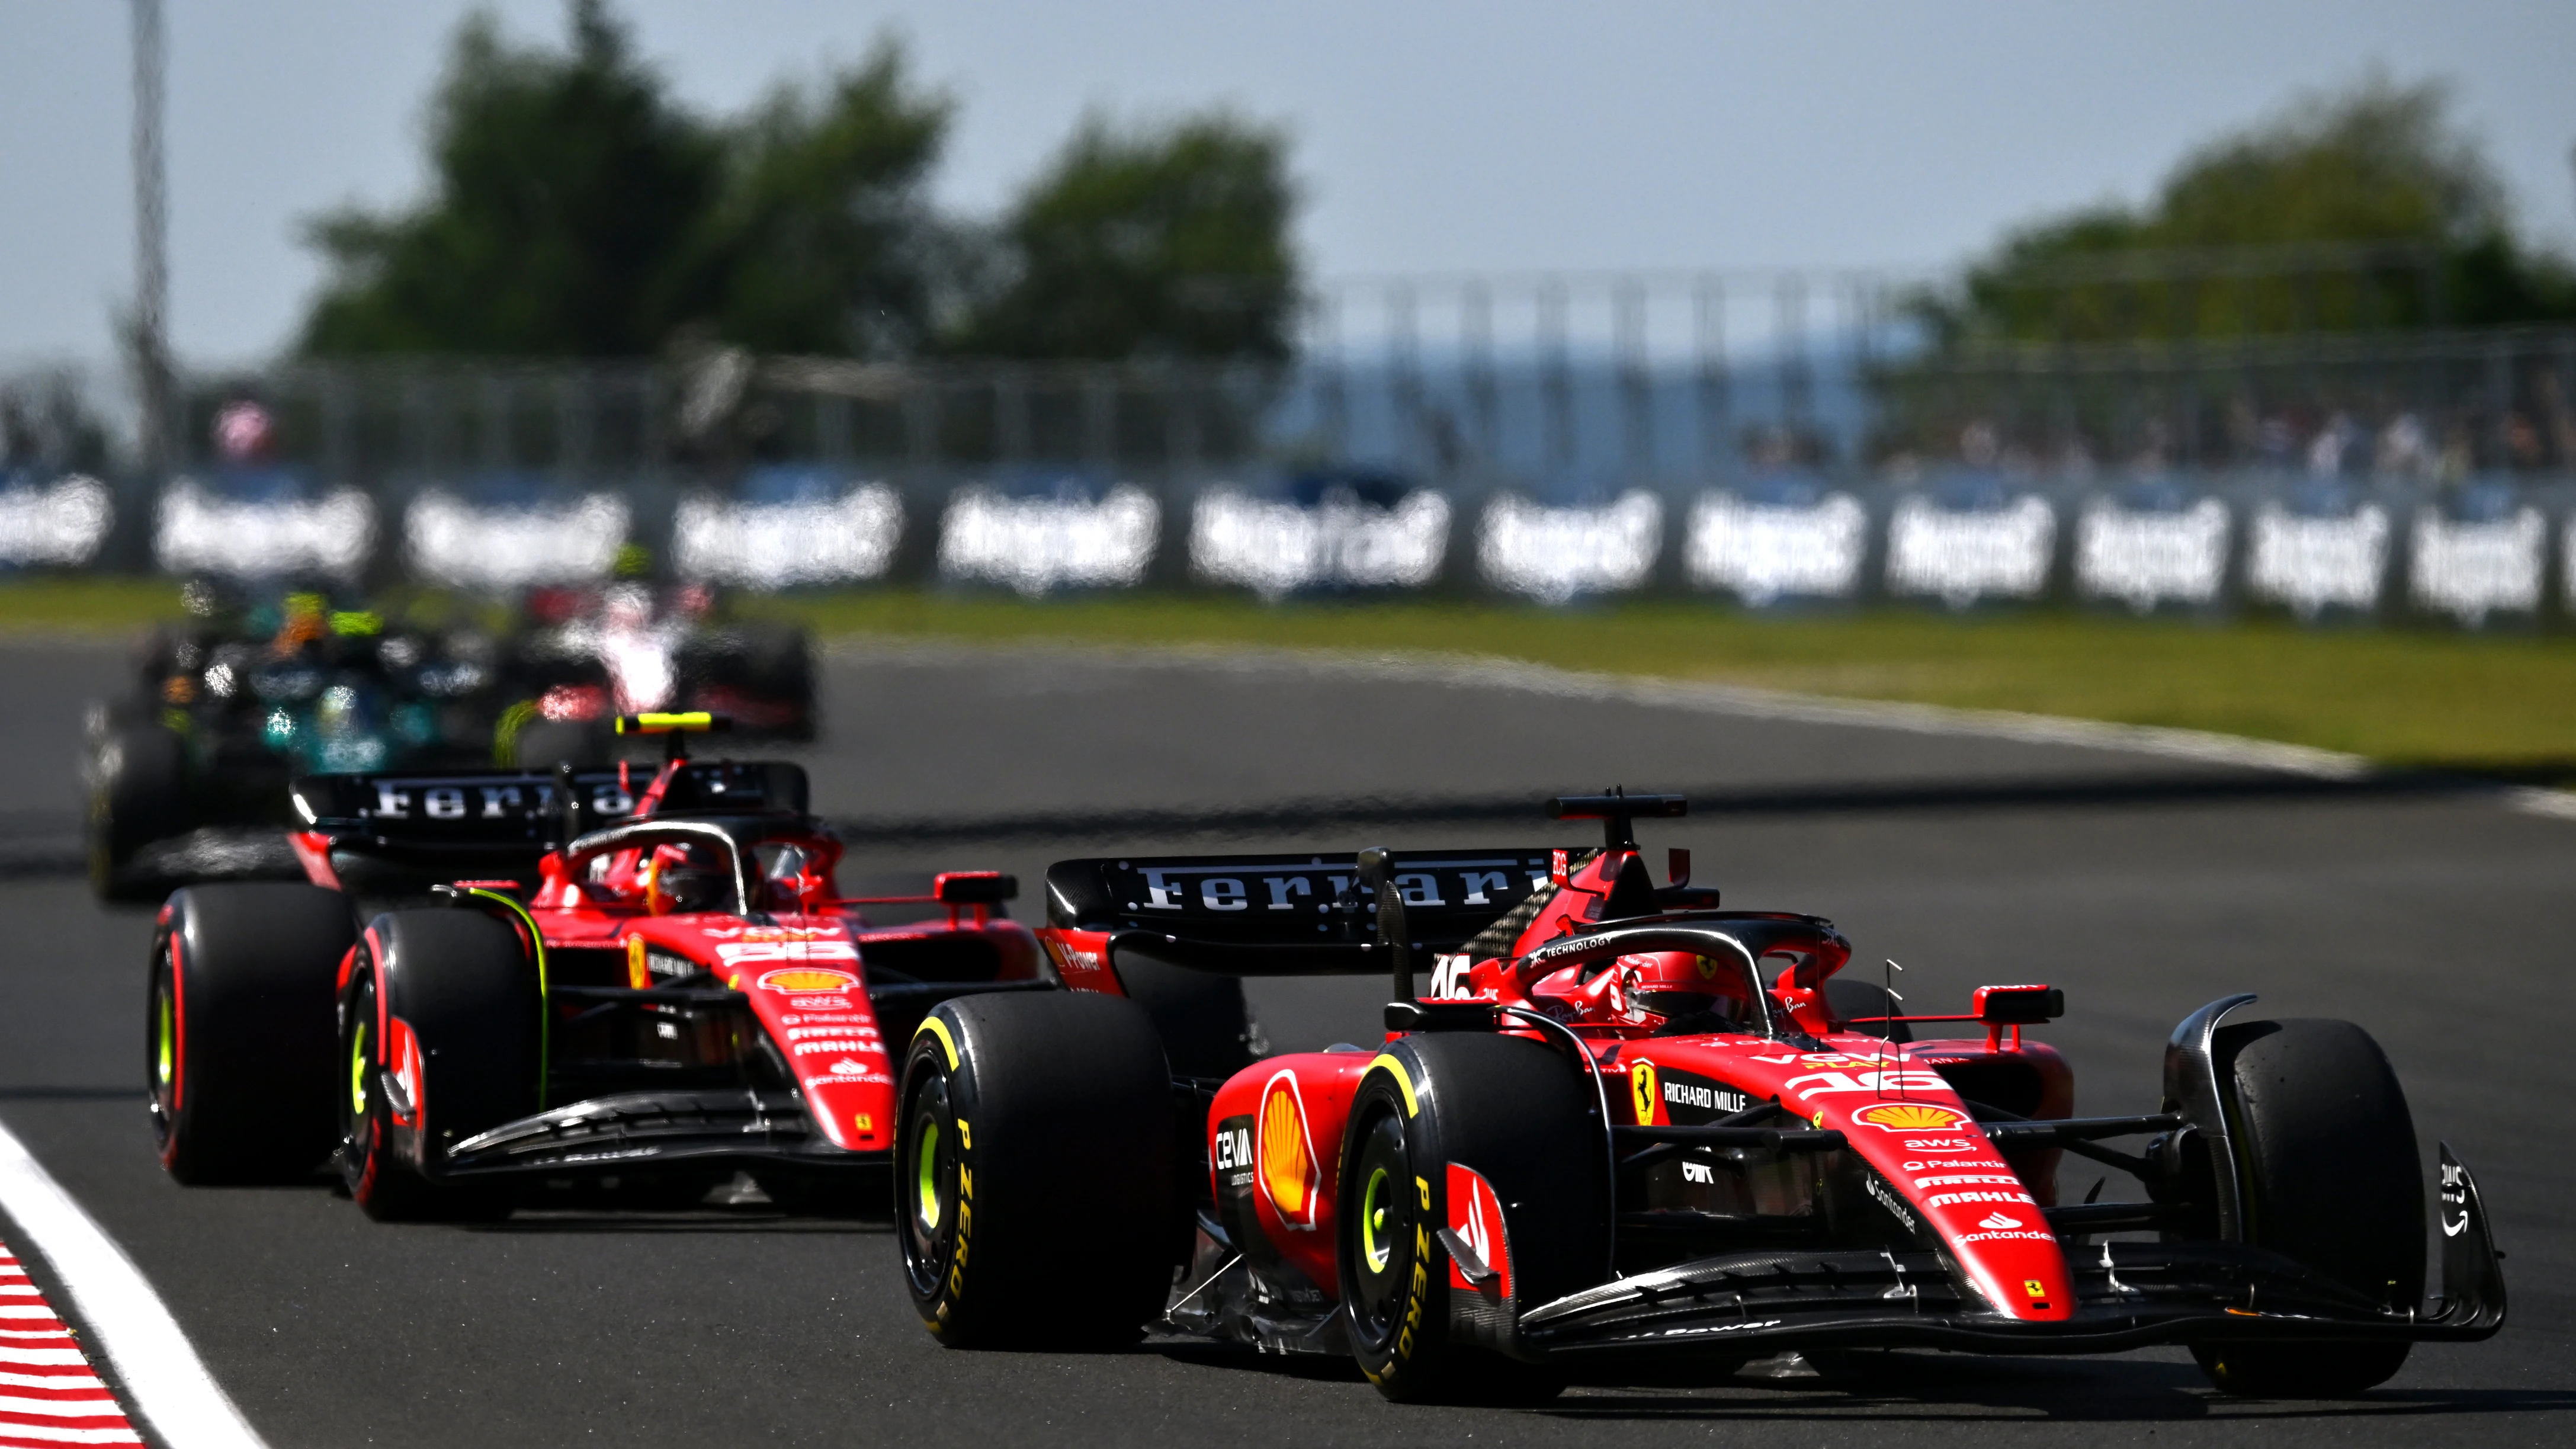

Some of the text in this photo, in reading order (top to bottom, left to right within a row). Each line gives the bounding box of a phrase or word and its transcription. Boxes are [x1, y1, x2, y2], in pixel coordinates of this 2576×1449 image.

[1547, 936, 1612, 957] TECHNOLOGY
[1624, 954, 1653, 969] Bitdefender
[1431, 954, 1470, 998] 16
[1749, 1053, 1911, 1064] VGW
[1664, 1082, 1711, 1108] RICHARD
[1784, 1070, 1956, 1101] 16
[1904, 1139, 1971, 1148] aws
[1926, 1159, 2008, 1169] Palantir
[1231, 1171, 1254, 1186] LOGISTICS
[1914, 1174, 2021, 1190] PIRELLI
[1874, 1179, 1916, 1235] Santander
[1928, 1191, 2037, 1208] MAHLE
[949, 1162, 973, 1300] ZERO
[1399, 1222, 1430, 1360] ZERO
